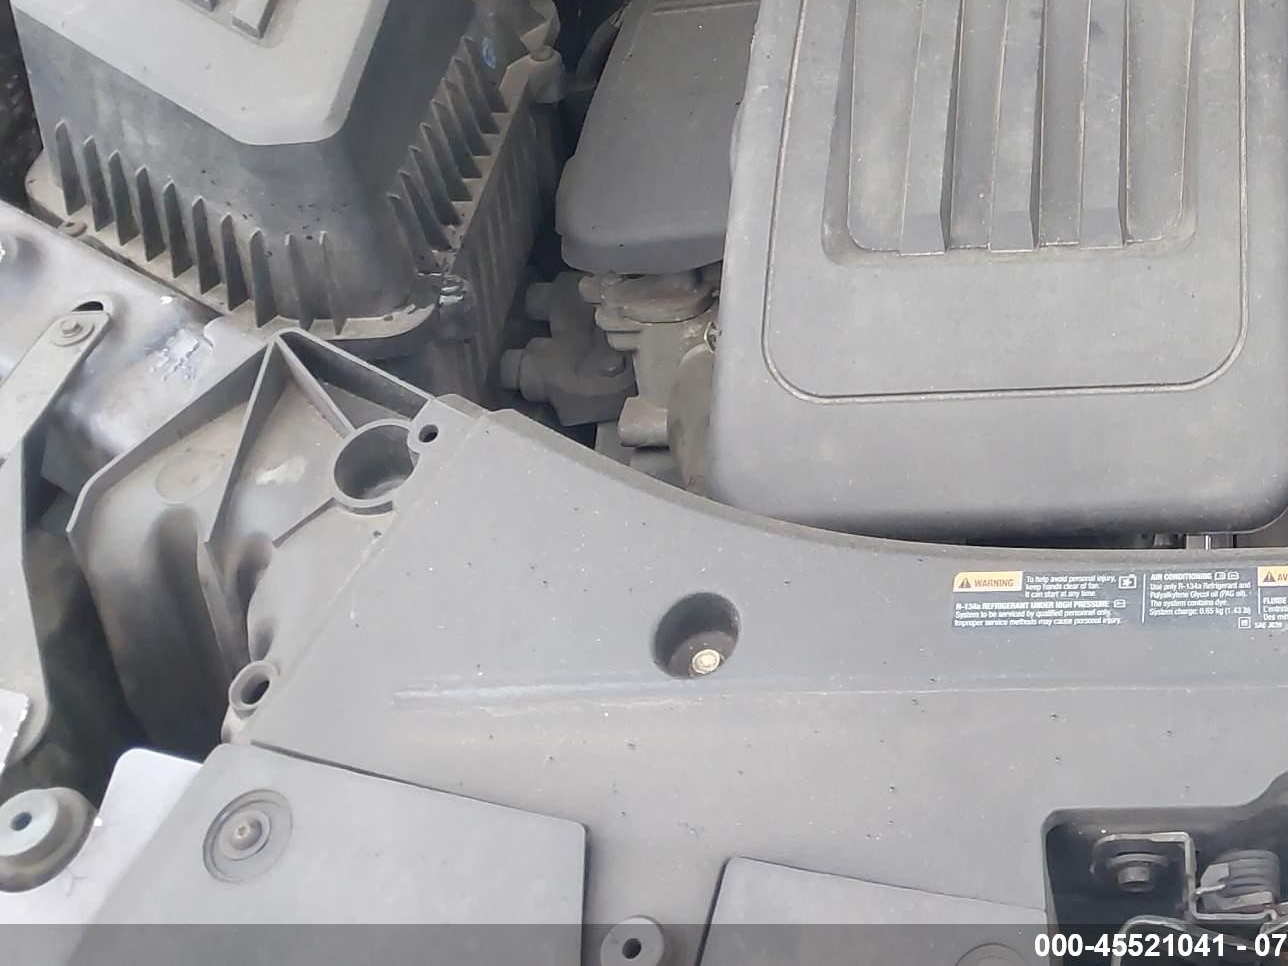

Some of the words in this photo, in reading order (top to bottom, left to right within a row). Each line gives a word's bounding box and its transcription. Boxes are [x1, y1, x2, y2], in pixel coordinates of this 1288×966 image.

[1025, 575, 1034, 584] To
[1034, 575, 1050, 585] help
[1050, 574, 1068, 583] avoid
[1068, 574, 1096, 584] personal
[1150, 573, 1163, 581] AIR
[1163, 572, 1213, 581] CONDITIONING
[974, 579, 1015, 588] WARNING
[1025, 583, 1042, 592] keep
[1042, 583, 1063, 591] hands
[1063, 583, 1080, 591] clear
[1080, 582, 1088, 590] of
[1150, 583, 1163, 591] Use
[1163, 583, 1178, 592] only
[1178, 582, 1202, 590] R-134a
[1203, 581, 1238, 590] Refrigerant
[1238, 581, 1251, 589] and
[955, 602, 981, 611] R-134a
[981, 601, 1030, 610] REFRIGERANT
[1030, 600, 1055, 609] UNDER
[1055, 600, 1073, 609] HIGH
[1073, 599, 1111, 608] PRESSURE
[1263, 596, 1287, 605] FLUIDE
